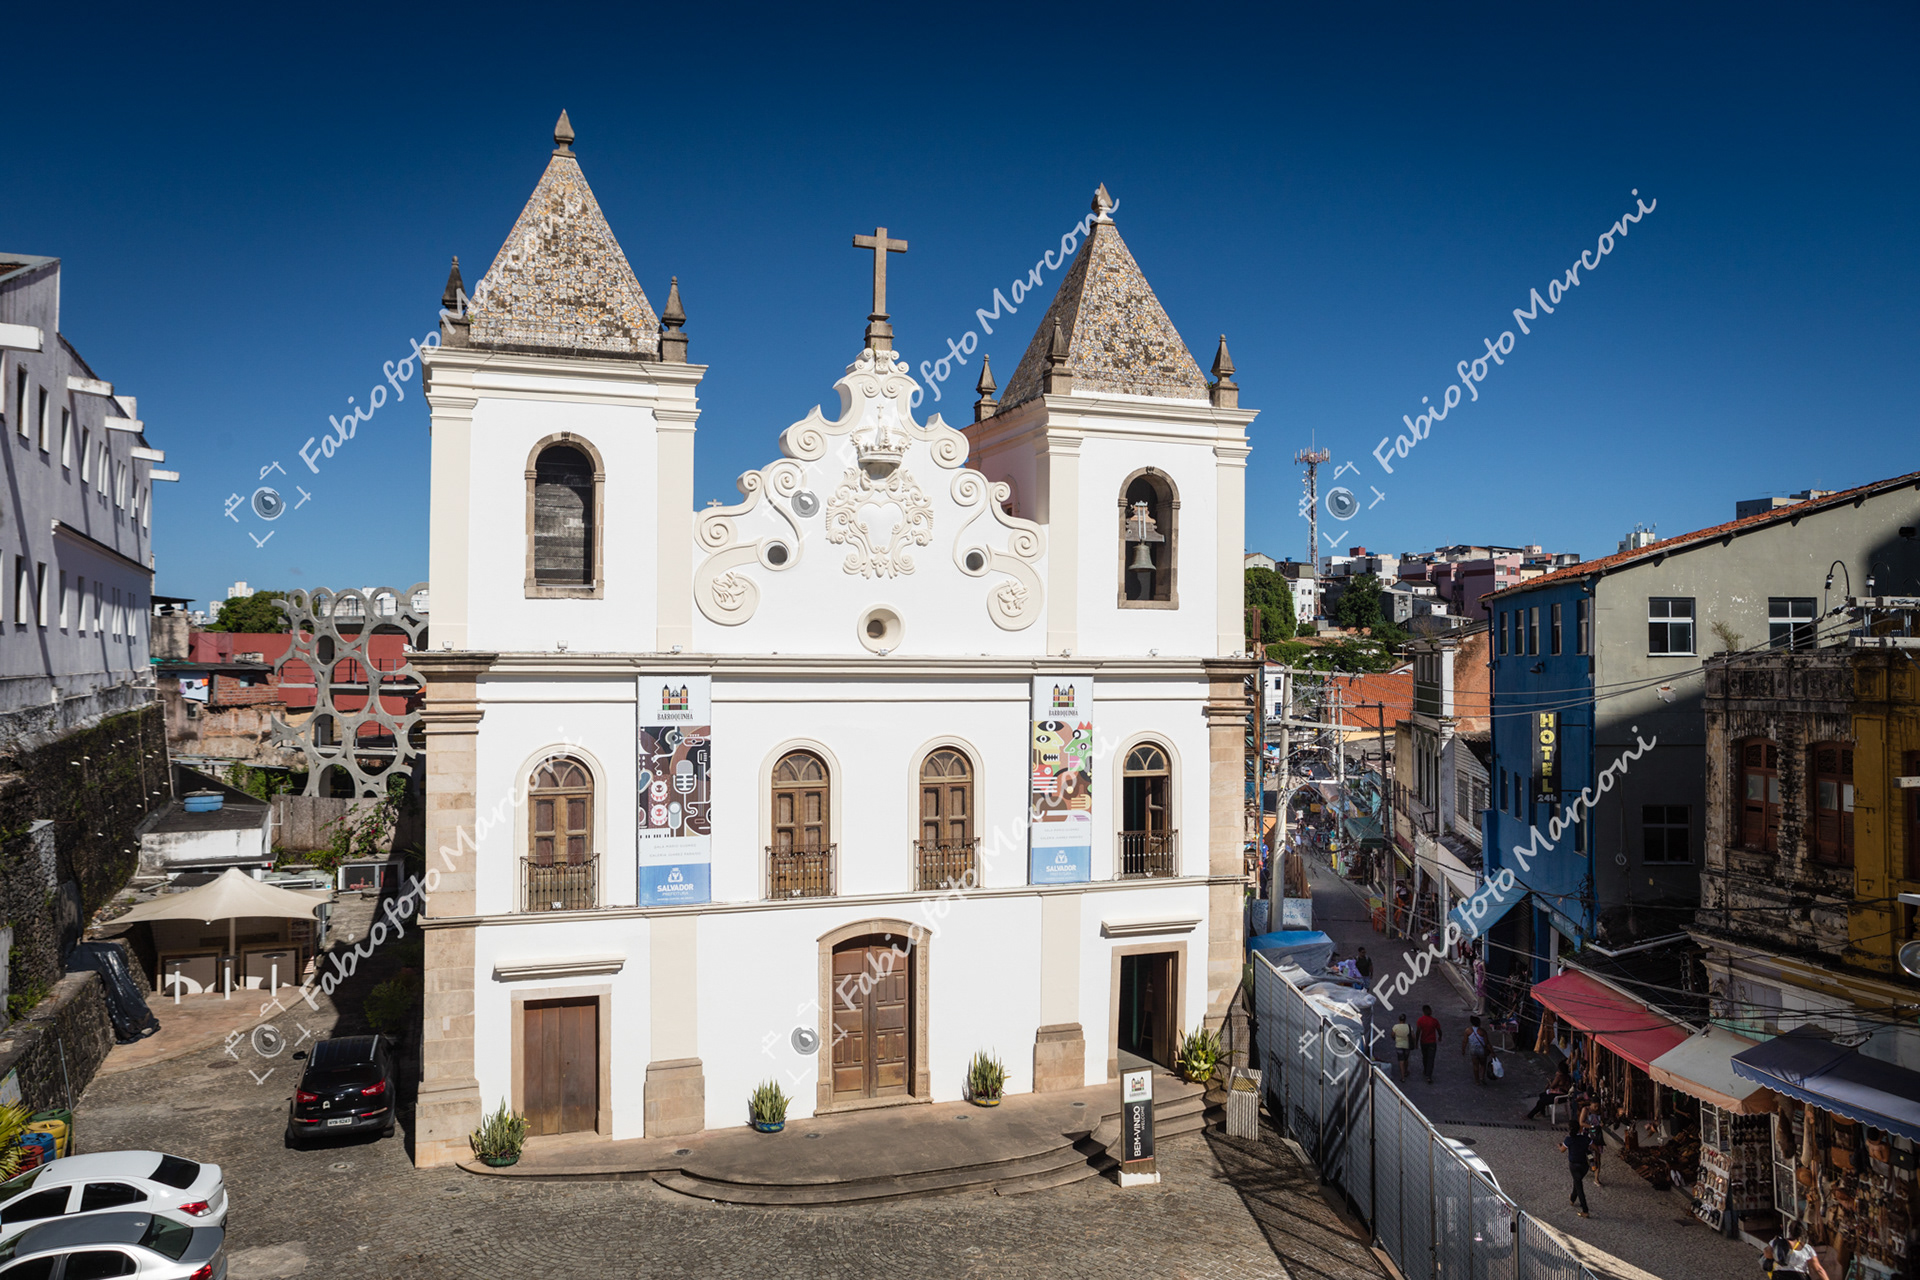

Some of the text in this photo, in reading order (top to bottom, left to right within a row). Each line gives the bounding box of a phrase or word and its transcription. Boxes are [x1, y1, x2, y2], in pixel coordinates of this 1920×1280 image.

[657, 713, 694, 721] BARROQUINHA
[1048, 709, 1079, 717] BARROQUINHA
[1540, 713, 1555, 793] HOTEL
[1046, 864, 1077, 872] SALVADOR
[657, 883, 694, 892] SALVADOR
[1133, 1105, 1141, 1157] BEM-VINDO
